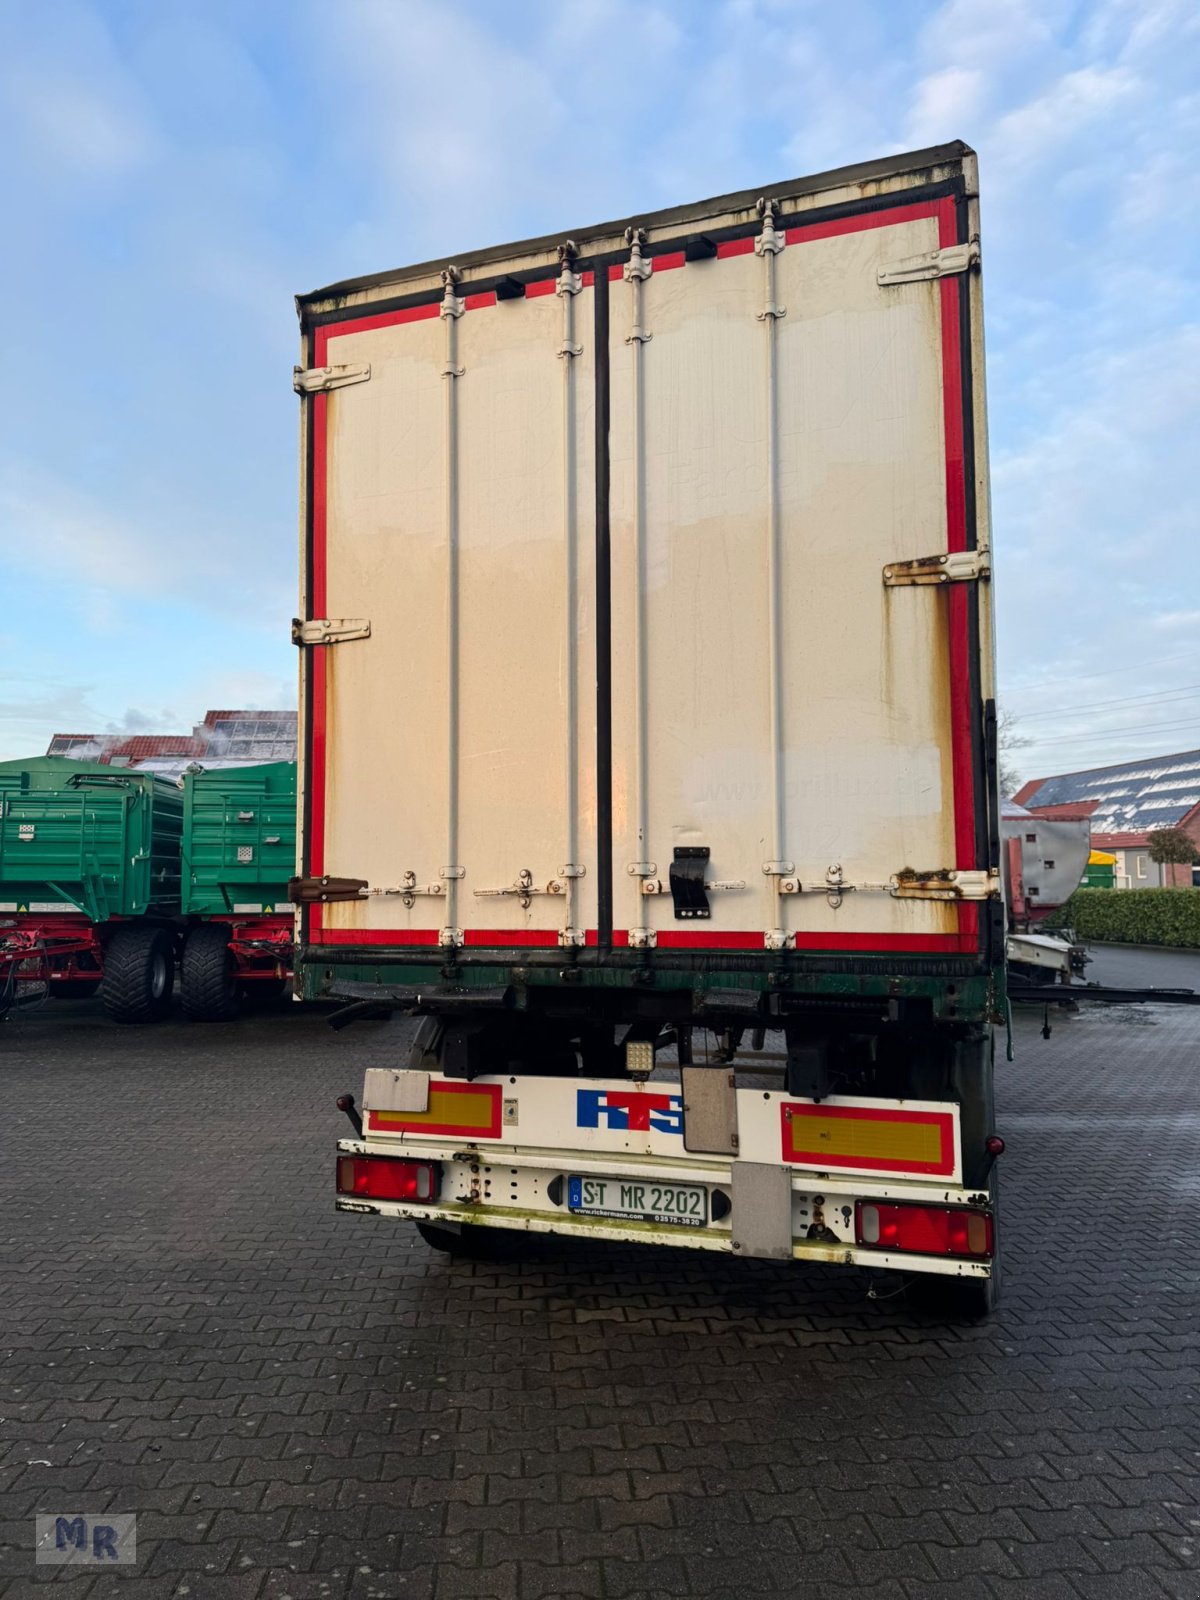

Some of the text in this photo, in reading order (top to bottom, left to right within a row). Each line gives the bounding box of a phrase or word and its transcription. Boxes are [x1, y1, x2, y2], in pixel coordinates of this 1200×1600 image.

[573, 1194, 579, 1202] D
[583, 1181, 701, 1215] ST MR 2202
[574, 1208, 644, 1221] www.rickermann.com
